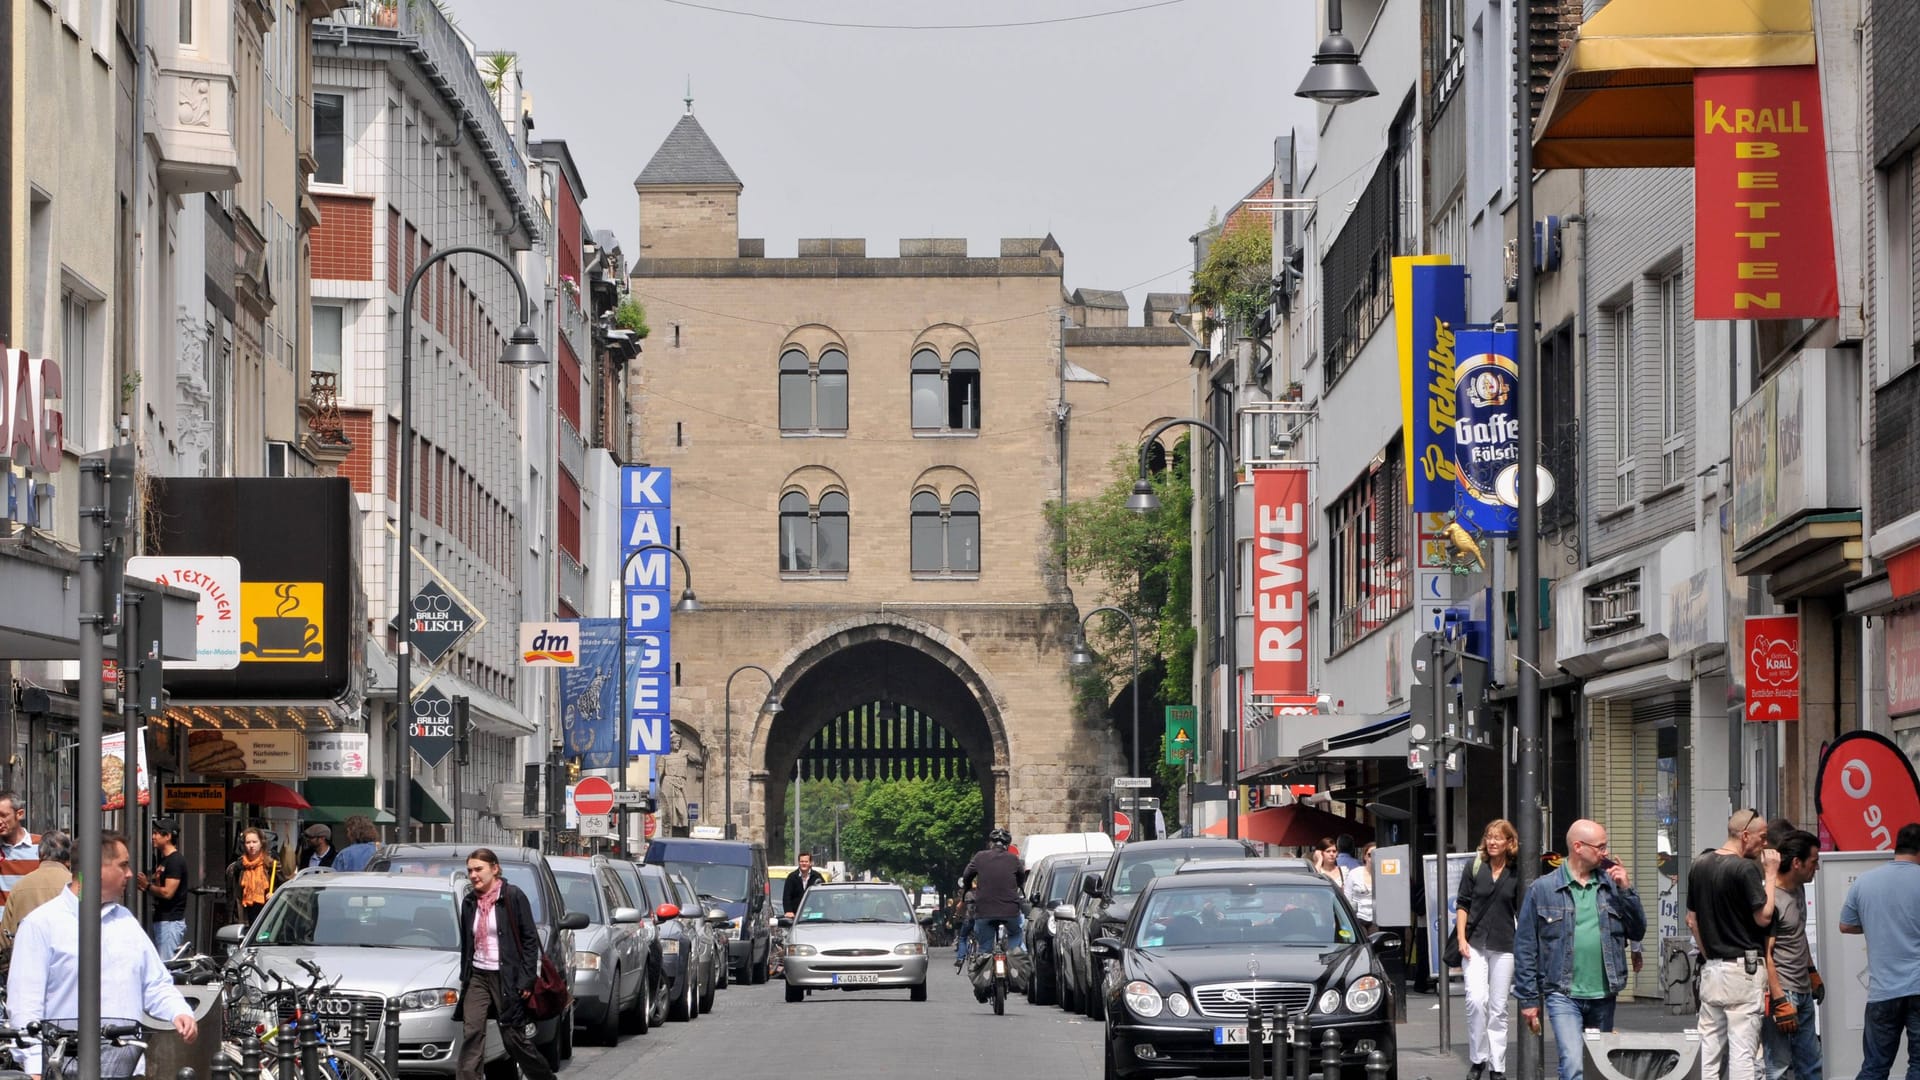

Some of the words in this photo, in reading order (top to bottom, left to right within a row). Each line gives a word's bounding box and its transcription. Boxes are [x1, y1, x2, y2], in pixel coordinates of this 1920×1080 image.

[1704, 100, 1809, 134] KRALL
[1734, 142, 1781, 310] BETTEN
[1428, 316, 1456, 435] Tchibo
[1455, 413, 1519, 445] Gaffe
[173, 569, 231, 620] TEXTILIEN
[1259, 503, 1303, 662] REWE
[416, 612, 449, 620] BRILLEN
[624, 470, 666, 751] KÄMPGEN
[532, 629, 569, 651] dm
[1766, 657, 1792, 669] KRALL
[307, 740, 363, 750] aratur
[1228, 1029, 1236, 1042] K
